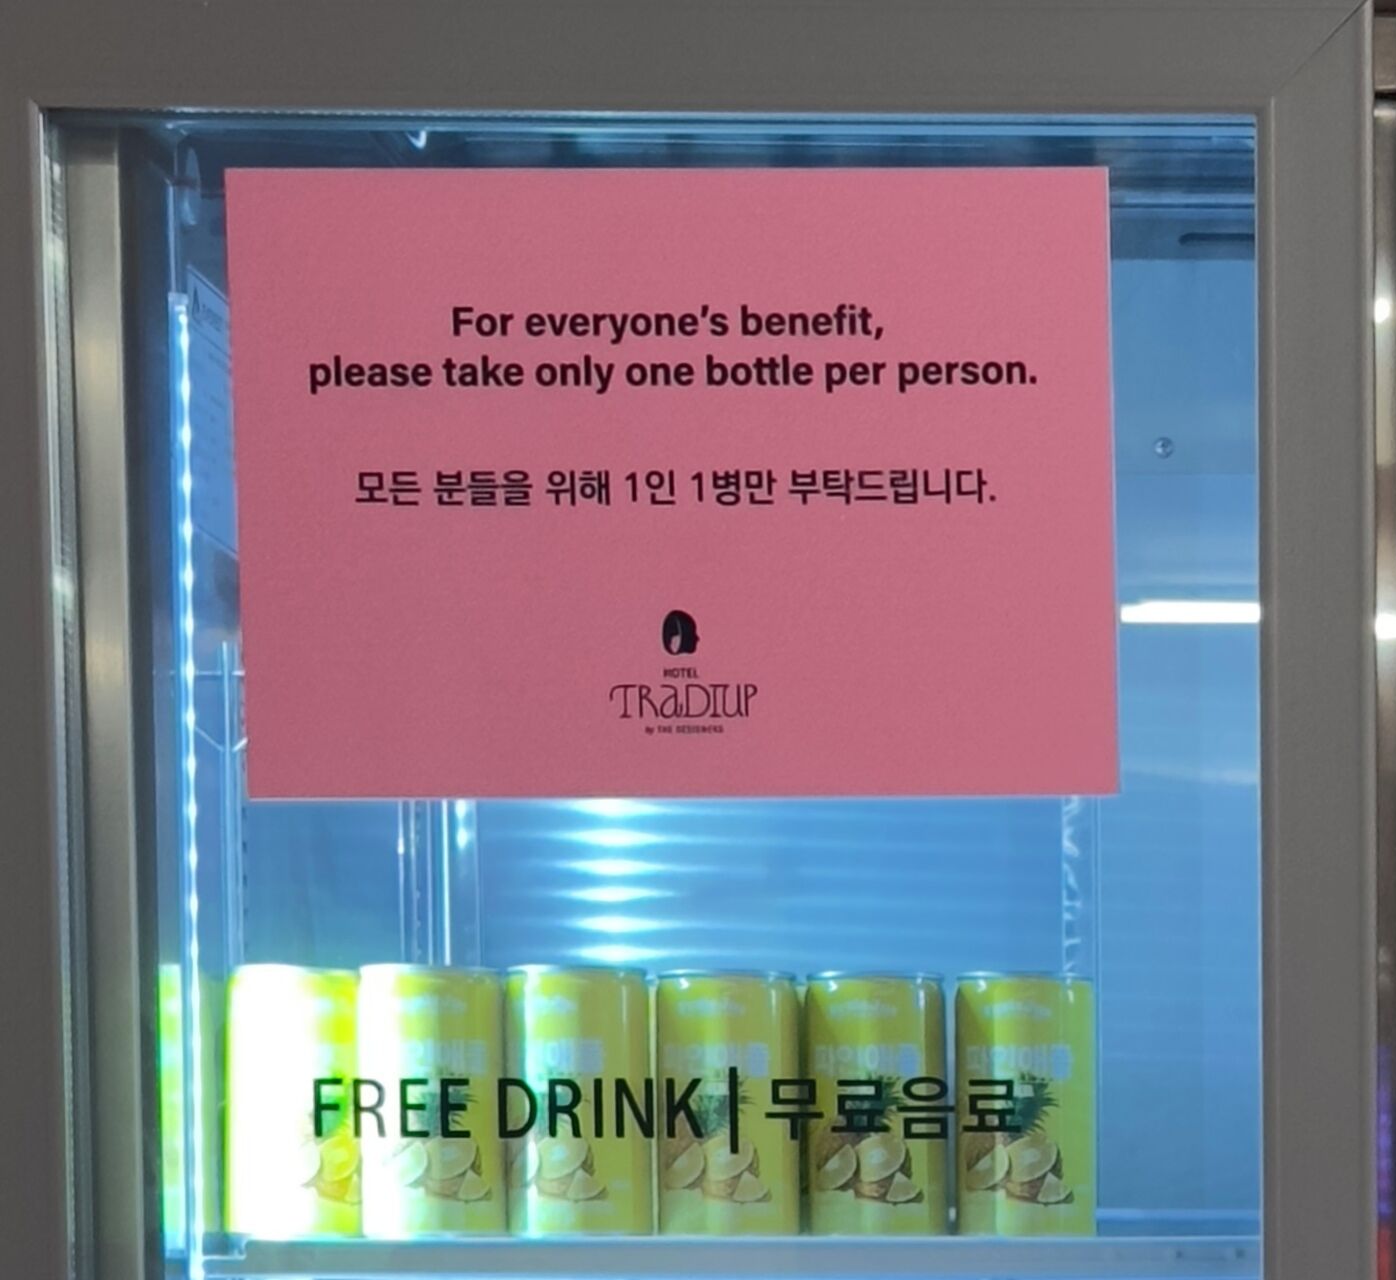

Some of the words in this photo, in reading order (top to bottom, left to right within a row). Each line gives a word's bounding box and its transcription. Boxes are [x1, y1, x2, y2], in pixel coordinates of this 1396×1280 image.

[453, 307, 514, 336] For
[526, 305, 728, 345] everyone's
[741, 304, 884, 341] benefit,
[309, 355, 433, 395] please
[442, 355, 525, 387] take
[536, 355, 615, 394] only
[626, 363, 695, 387] one
[706, 354, 814, 387] bottle
[826, 362, 887, 393] per
[899, 362, 1037, 393] person.
[355, 472, 422, 506] 모든
[434, 470, 534, 506] 분들을
[546, 470, 611, 507] 위해
[626, 470, 676, 506] 1인
[692, 470, 778, 507] 1병만
[789, 469, 997, 506] 부탁드립니다.
[663, 668, 699, 679] HOTEL
[312, 1077, 471, 1139] FREE
[498, 1077, 705, 1139] DRINK
[765, 1075, 1022, 1141] 무료음료
